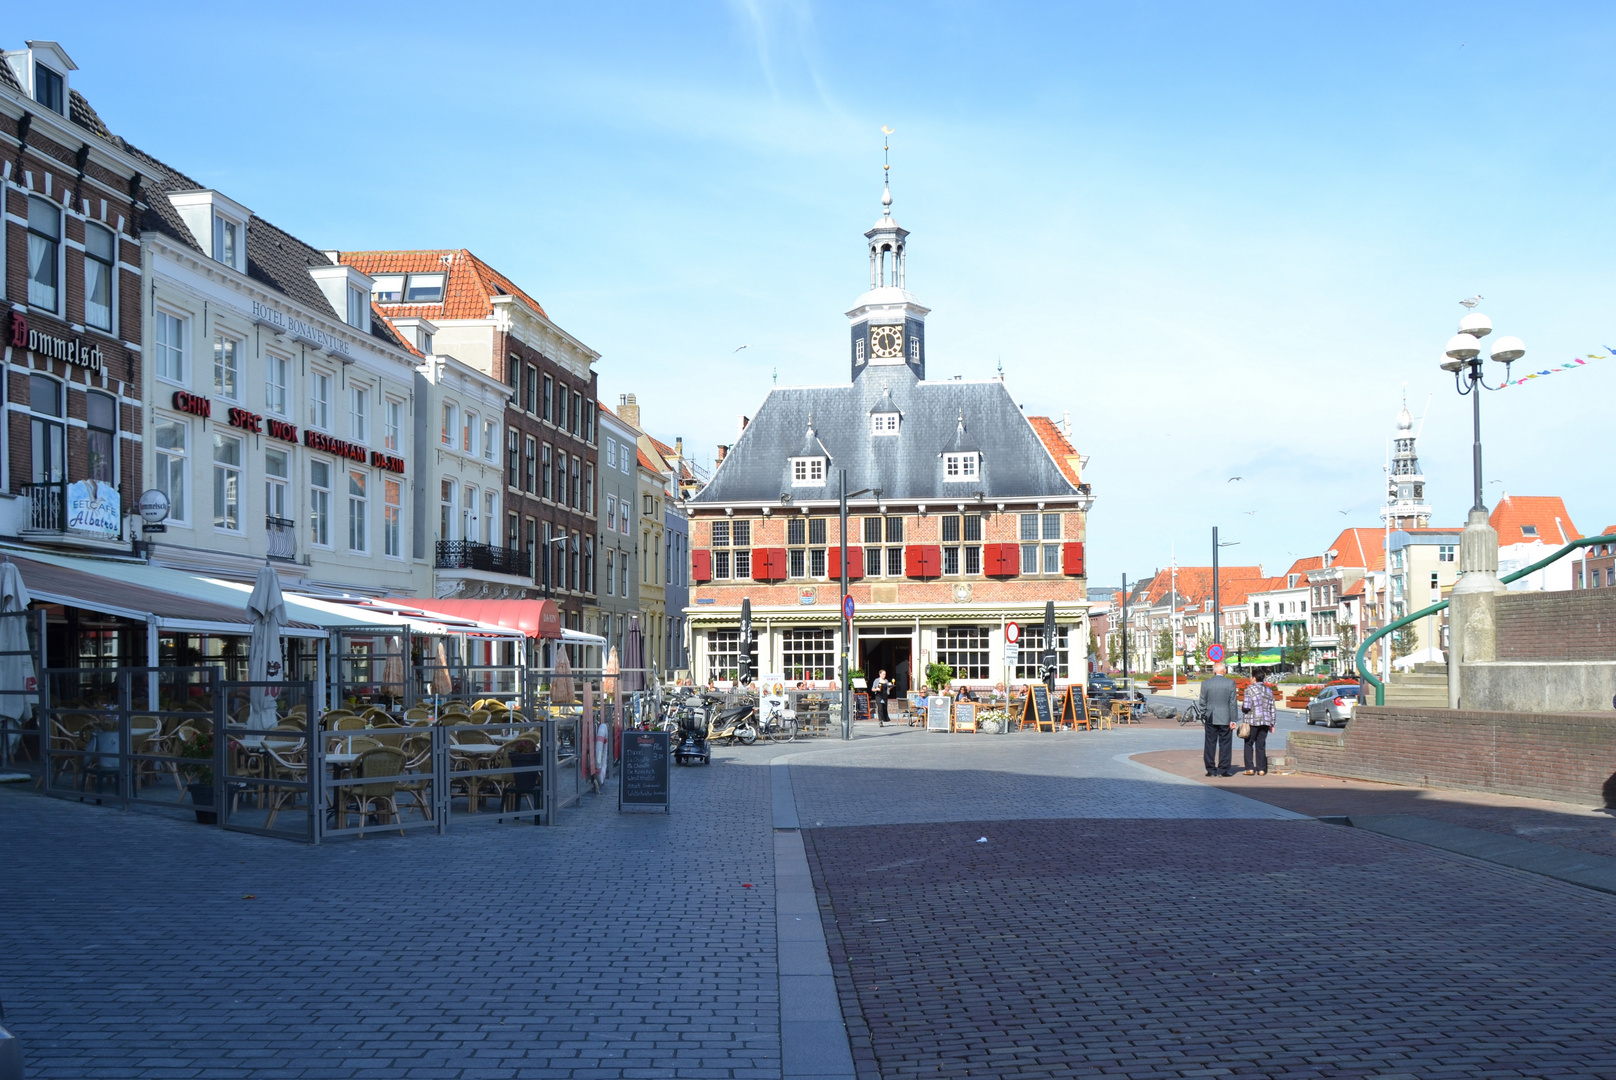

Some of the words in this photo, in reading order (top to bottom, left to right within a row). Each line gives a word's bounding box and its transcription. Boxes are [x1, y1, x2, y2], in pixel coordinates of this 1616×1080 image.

[11, 311, 104, 376] Dommelsch
[252, 300, 286, 328] HOTEL
[288, 316, 350, 355] BONAVENTURE
[175, 390, 211, 418] CHIN
[230, 406, 263, 433] SPEC
[270, 418, 299, 443] WOK
[307, 430, 367, 463] RESTAURANT
[373, 451, 405, 474] DA-XIN
[69, 510, 119, 532] Albatros
[72, 500, 117, 517] EETCAFE
